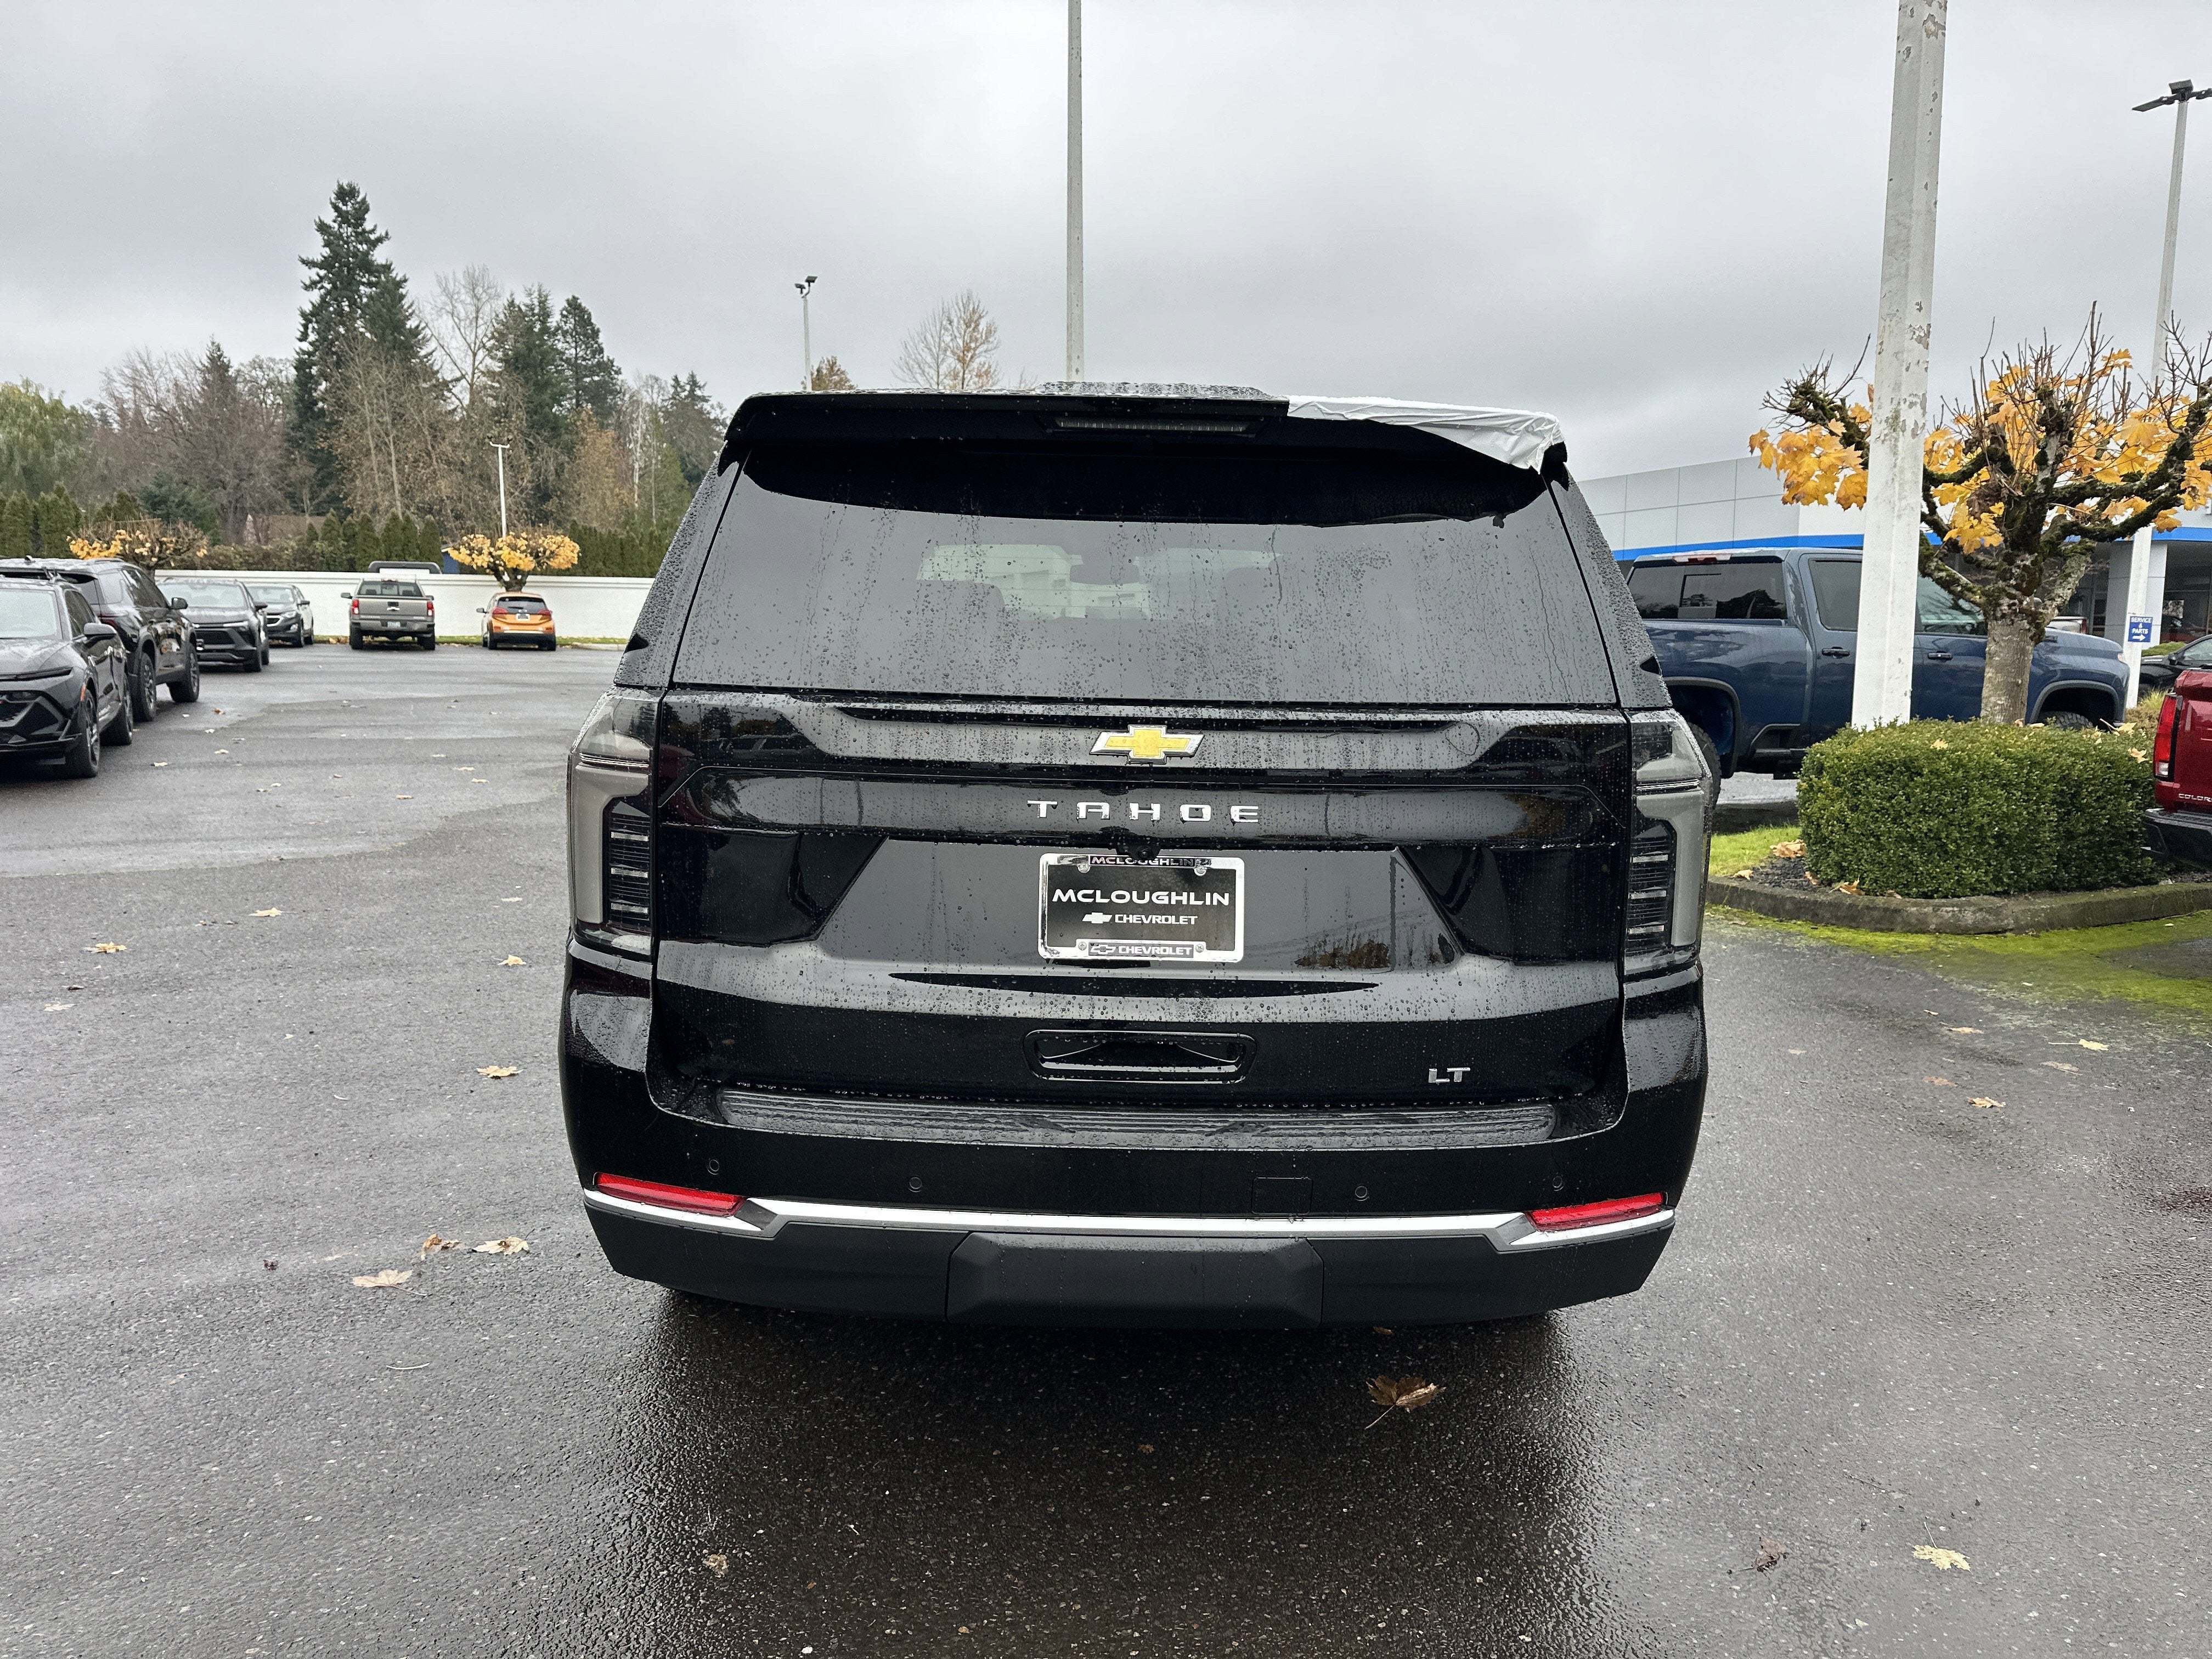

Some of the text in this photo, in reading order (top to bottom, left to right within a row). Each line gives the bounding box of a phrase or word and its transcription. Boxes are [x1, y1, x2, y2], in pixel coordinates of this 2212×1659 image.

[2179, 793, 2212, 802] COLOR
[1027, 800, 1259, 823] TAHOE
[1052, 889, 1229, 906] MCLOUGHLIN
[1115, 914, 1198, 925] CHEVROLET
[1118, 945, 1193, 956] CHEVROLET
[1428, 1067, 1471, 1083] LT
